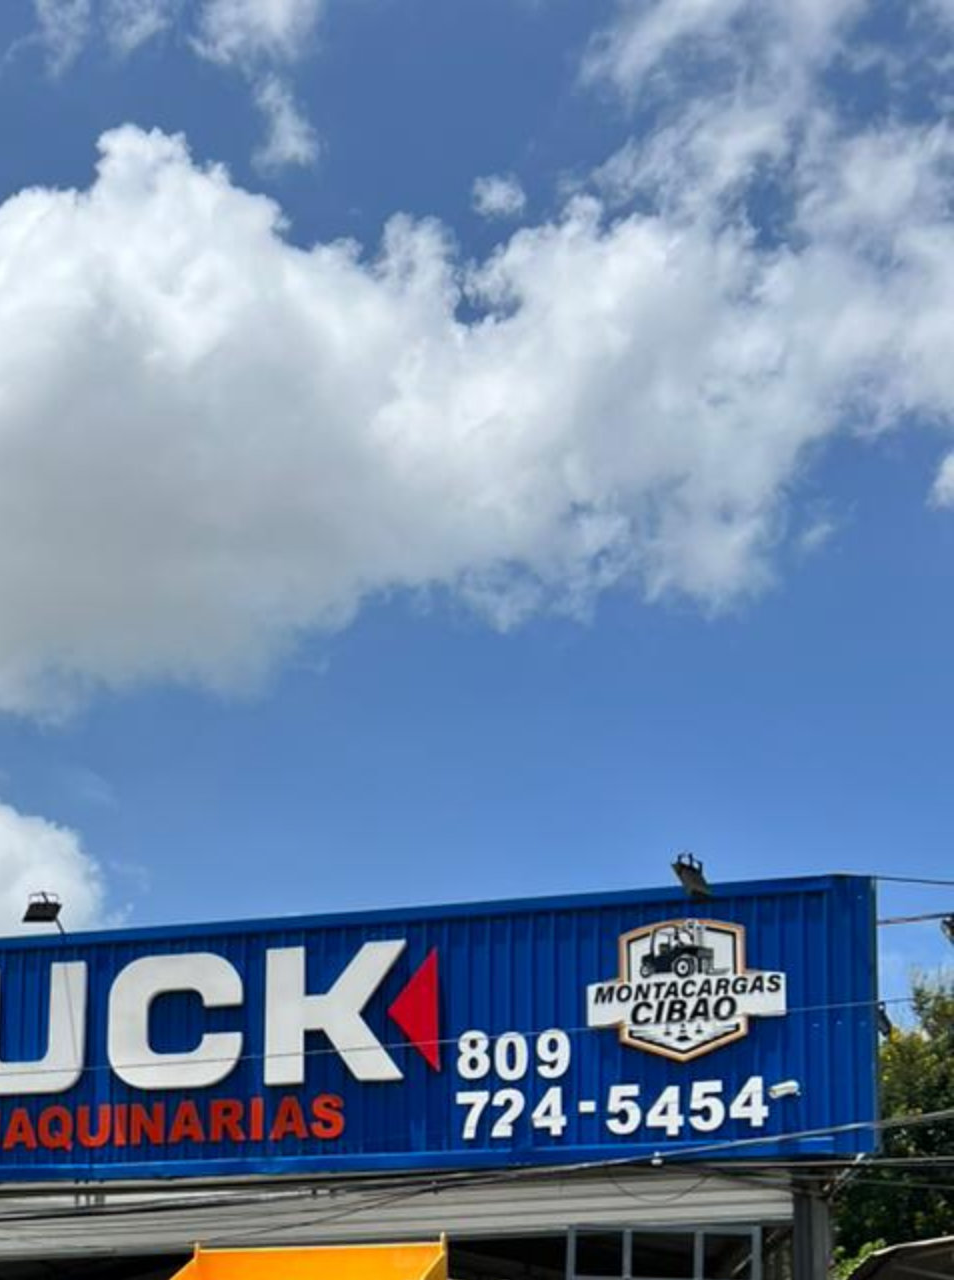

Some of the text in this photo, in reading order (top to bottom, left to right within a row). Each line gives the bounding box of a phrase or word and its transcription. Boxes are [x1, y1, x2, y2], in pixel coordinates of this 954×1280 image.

[594, 974, 782, 1004] MONTACARGAS
[631, 996, 737, 1025] CIBAO
[456, 1029, 572, 1081] 809
